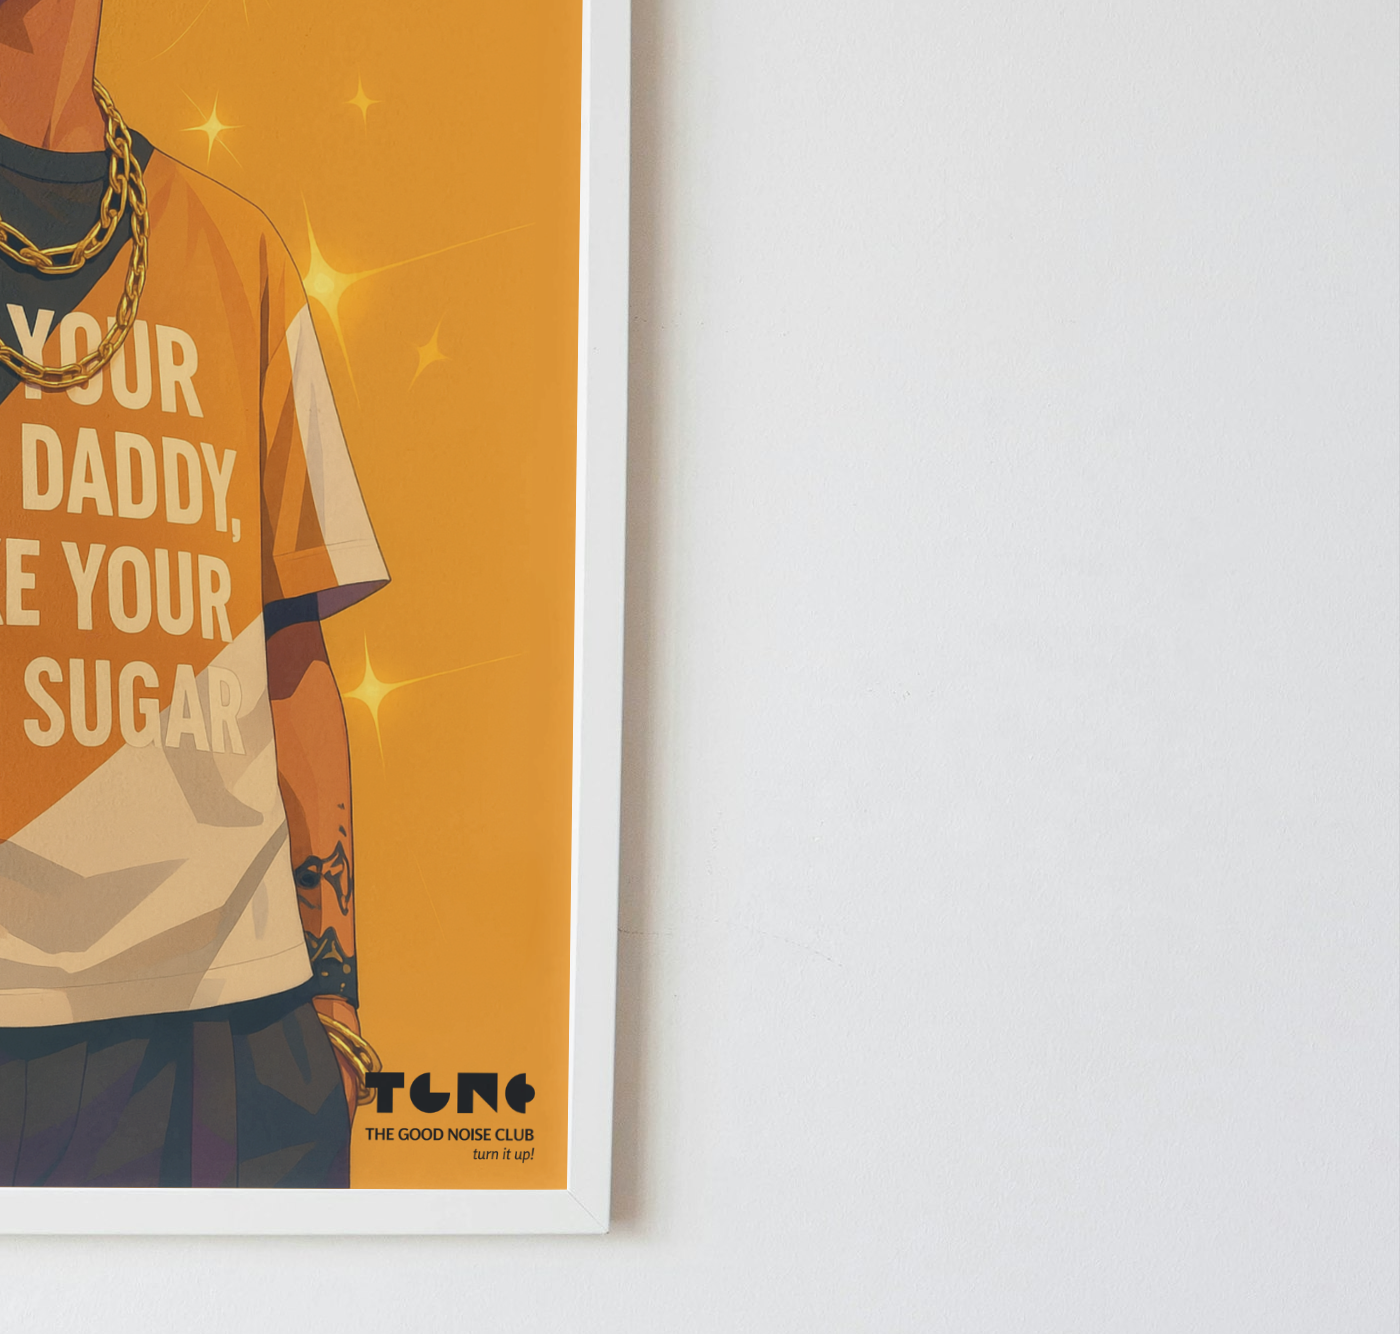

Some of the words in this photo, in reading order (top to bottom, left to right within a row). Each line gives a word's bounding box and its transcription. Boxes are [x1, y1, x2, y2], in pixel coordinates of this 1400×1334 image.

[6, 302, 204, 418] YOUR
[21, 422, 241, 543] DADDY,
[60, 540, 233, 643] YOUR
[23, 656, 246, 756] SUGAR
[365, 1128, 395, 1140] THE
[398, 1128, 444, 1141] GOOD
[448, 1128, 492, 1141] NOISE
[495, 1128, 534, 1141] CLUB
[473, 1148, 499, 1160] turn
[502, 1147, 511, 1160] it
[514, 1147, 535, 1163] up!
